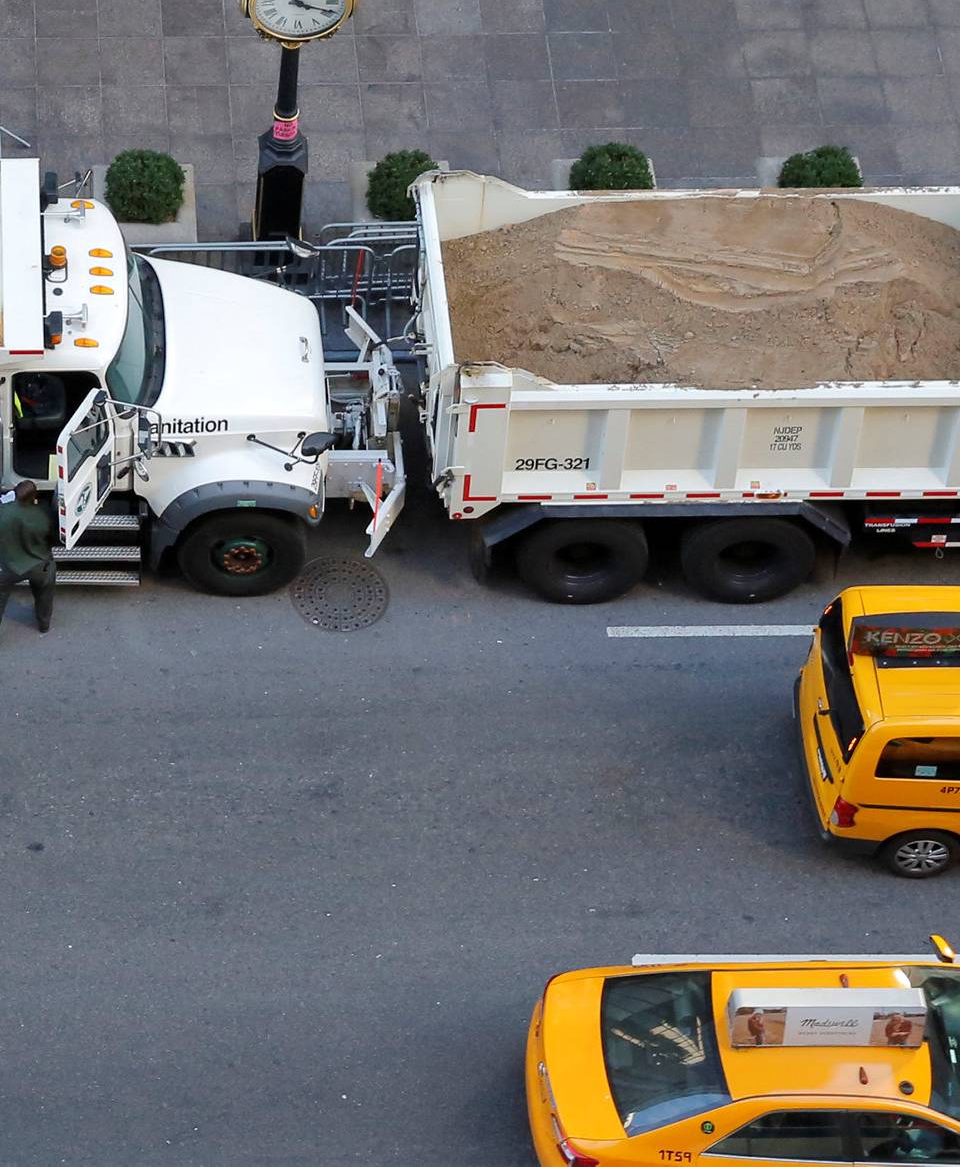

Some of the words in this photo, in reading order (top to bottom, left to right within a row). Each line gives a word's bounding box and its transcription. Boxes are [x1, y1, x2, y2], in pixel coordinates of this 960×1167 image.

[150, 417, 228, 434] anitation
[515, 457, 590, 471] 29FG-321
[865, 631, 941, 644] KENZO
[939, 786, 960, 795] 4P7
